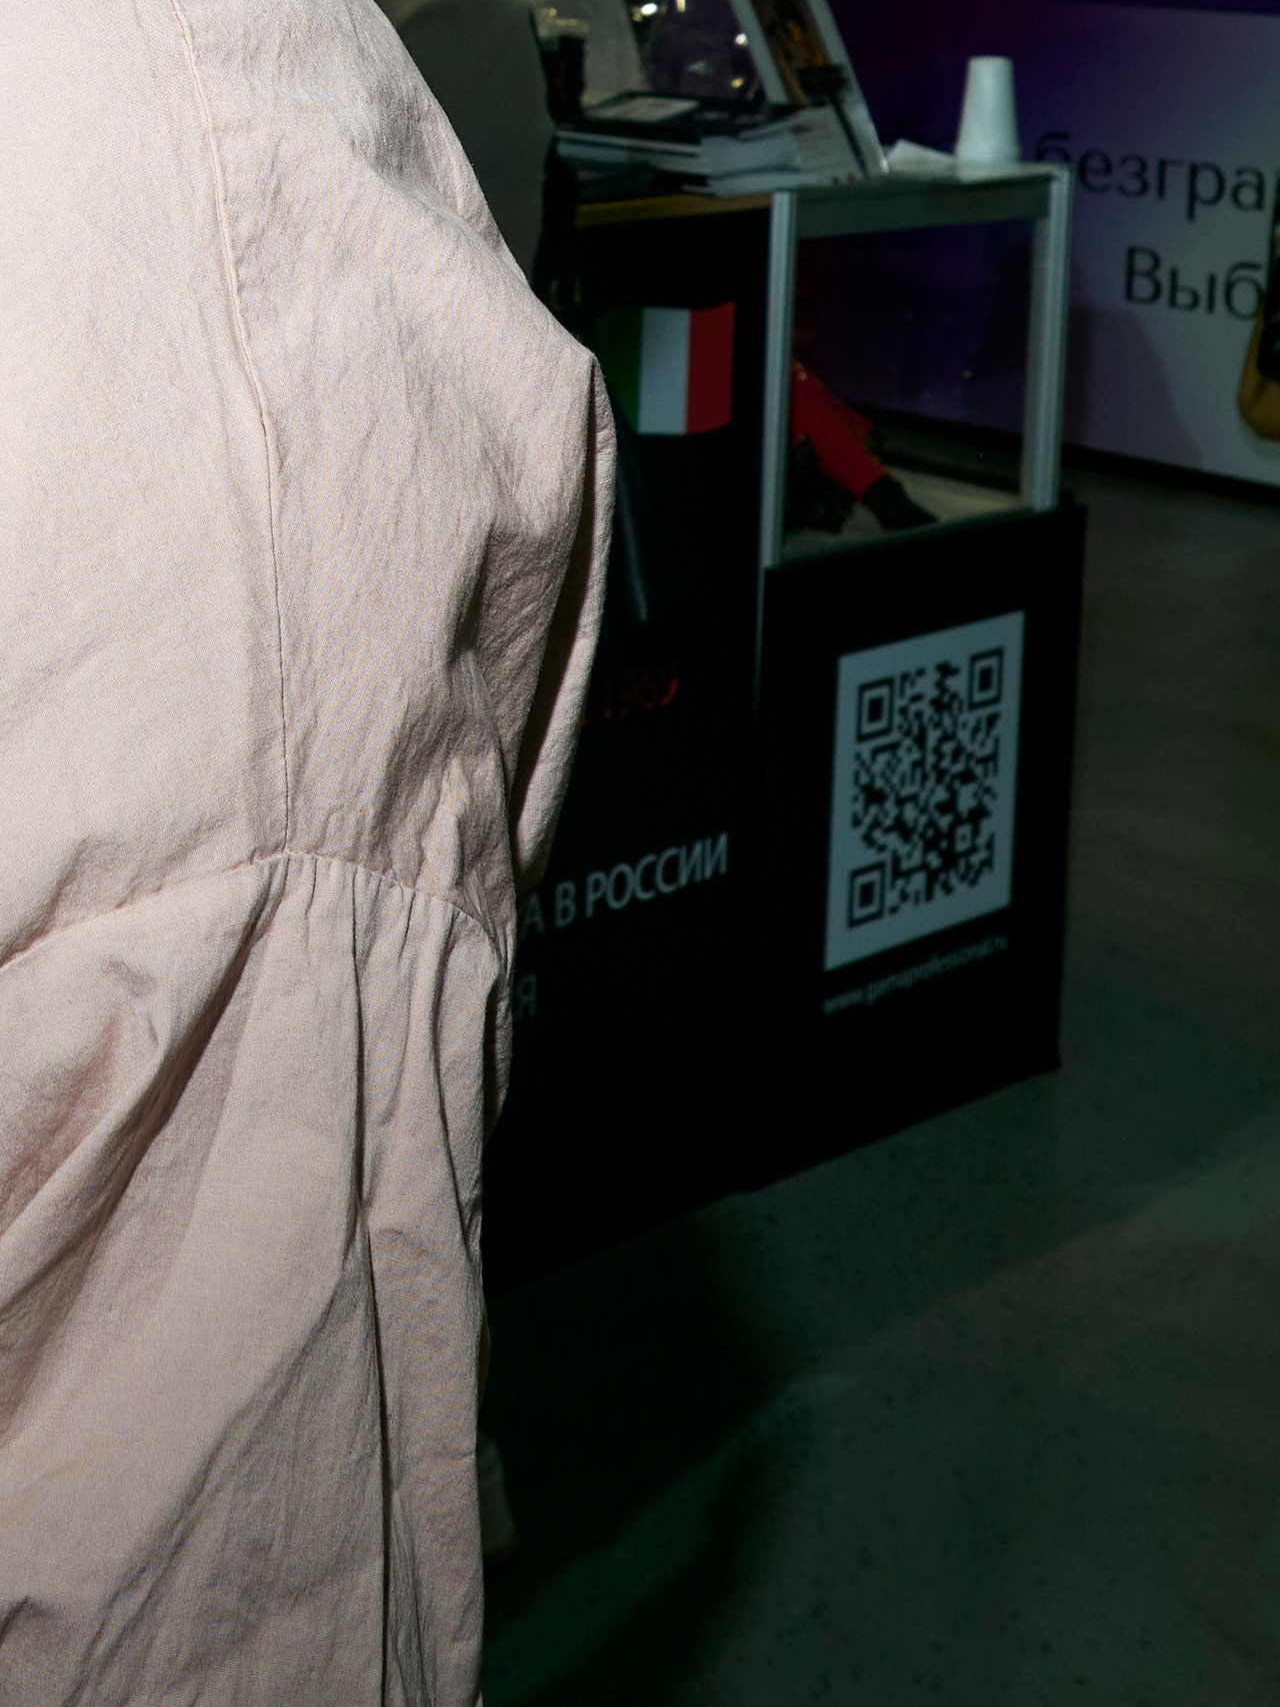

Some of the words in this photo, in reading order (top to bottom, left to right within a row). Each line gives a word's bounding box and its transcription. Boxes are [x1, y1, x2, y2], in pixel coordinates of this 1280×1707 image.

[1036, 132, 1280, 222] безгра
[554, 879, 577, 929] В
[584, 830, 729, 920] РОССИИ
